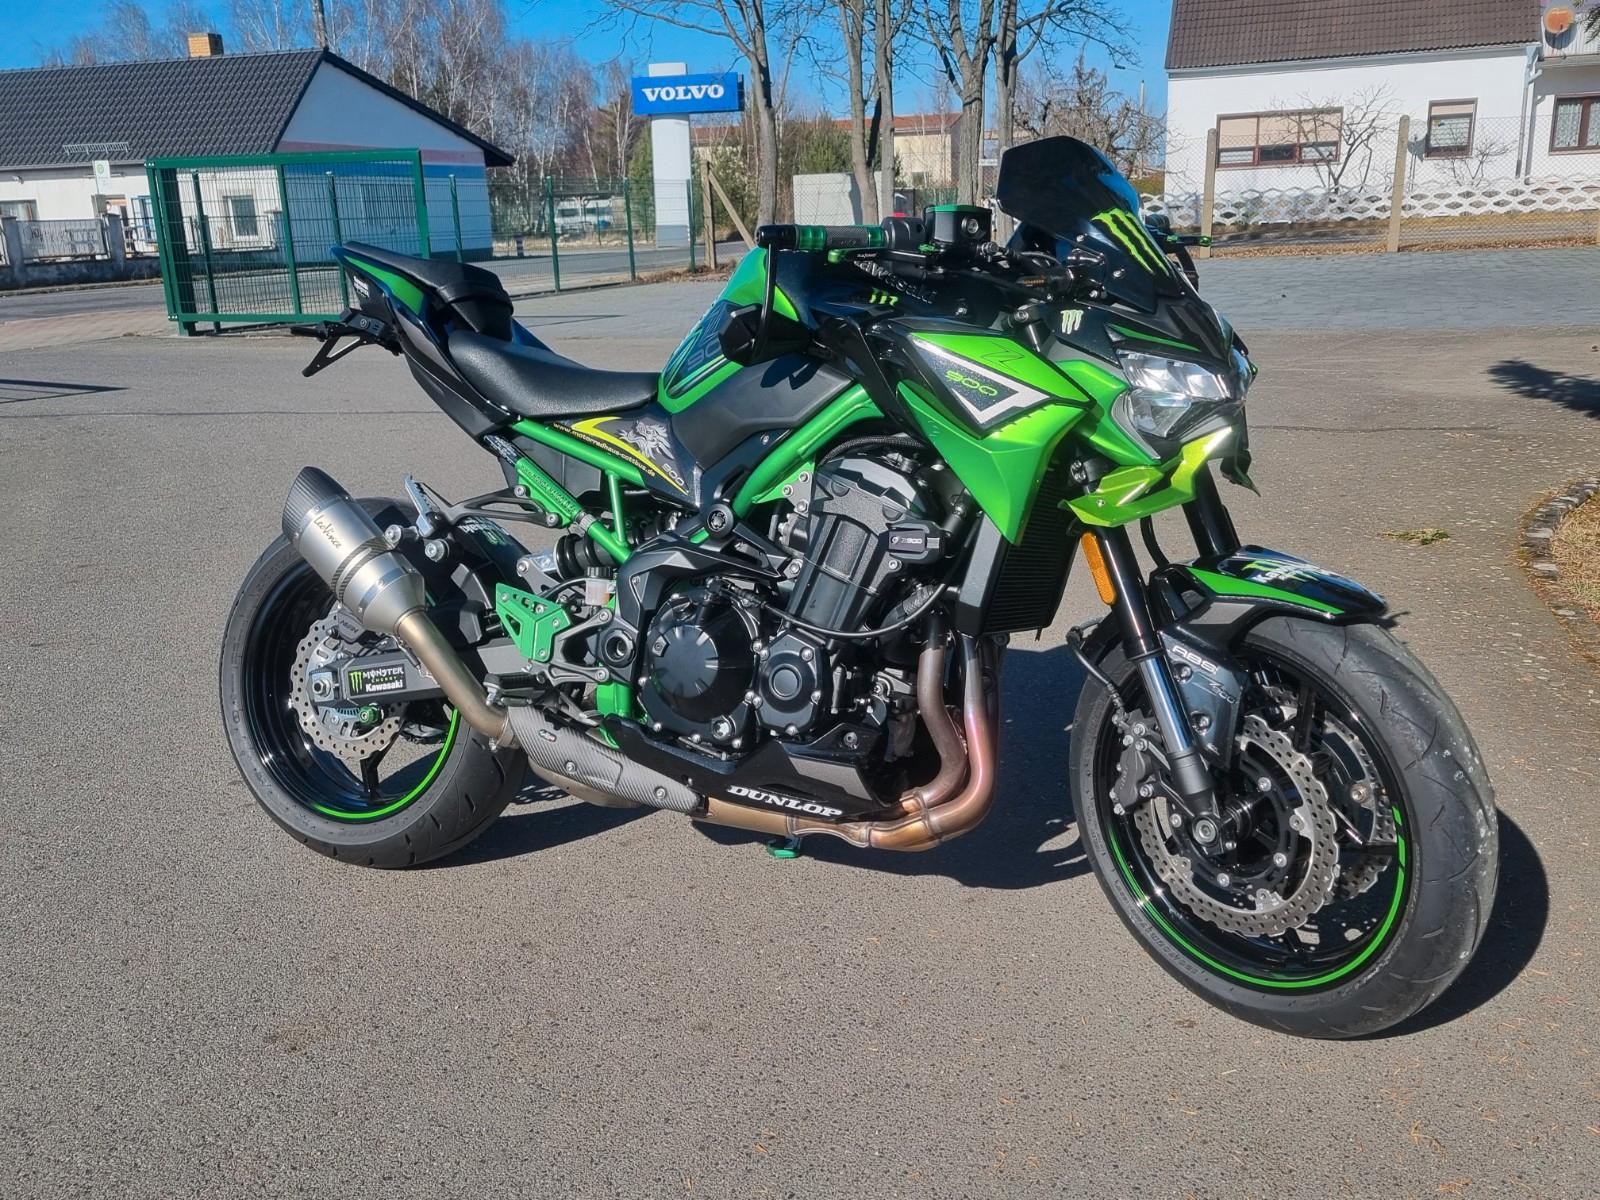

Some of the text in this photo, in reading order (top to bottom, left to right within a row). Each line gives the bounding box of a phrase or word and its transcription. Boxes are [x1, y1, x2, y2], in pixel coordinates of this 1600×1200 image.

[642, 84, 724, 102] VOLVO
[945, 370, 998, 396] 900
[661, 463, 685, 486] 900
[1172, 645, 1218, 675] ABS
[362, 667, 404, 679] MONSTER
[365, 680, 403, 693] Kawasaki
[726, 785, 843, 817] DUNLOP
